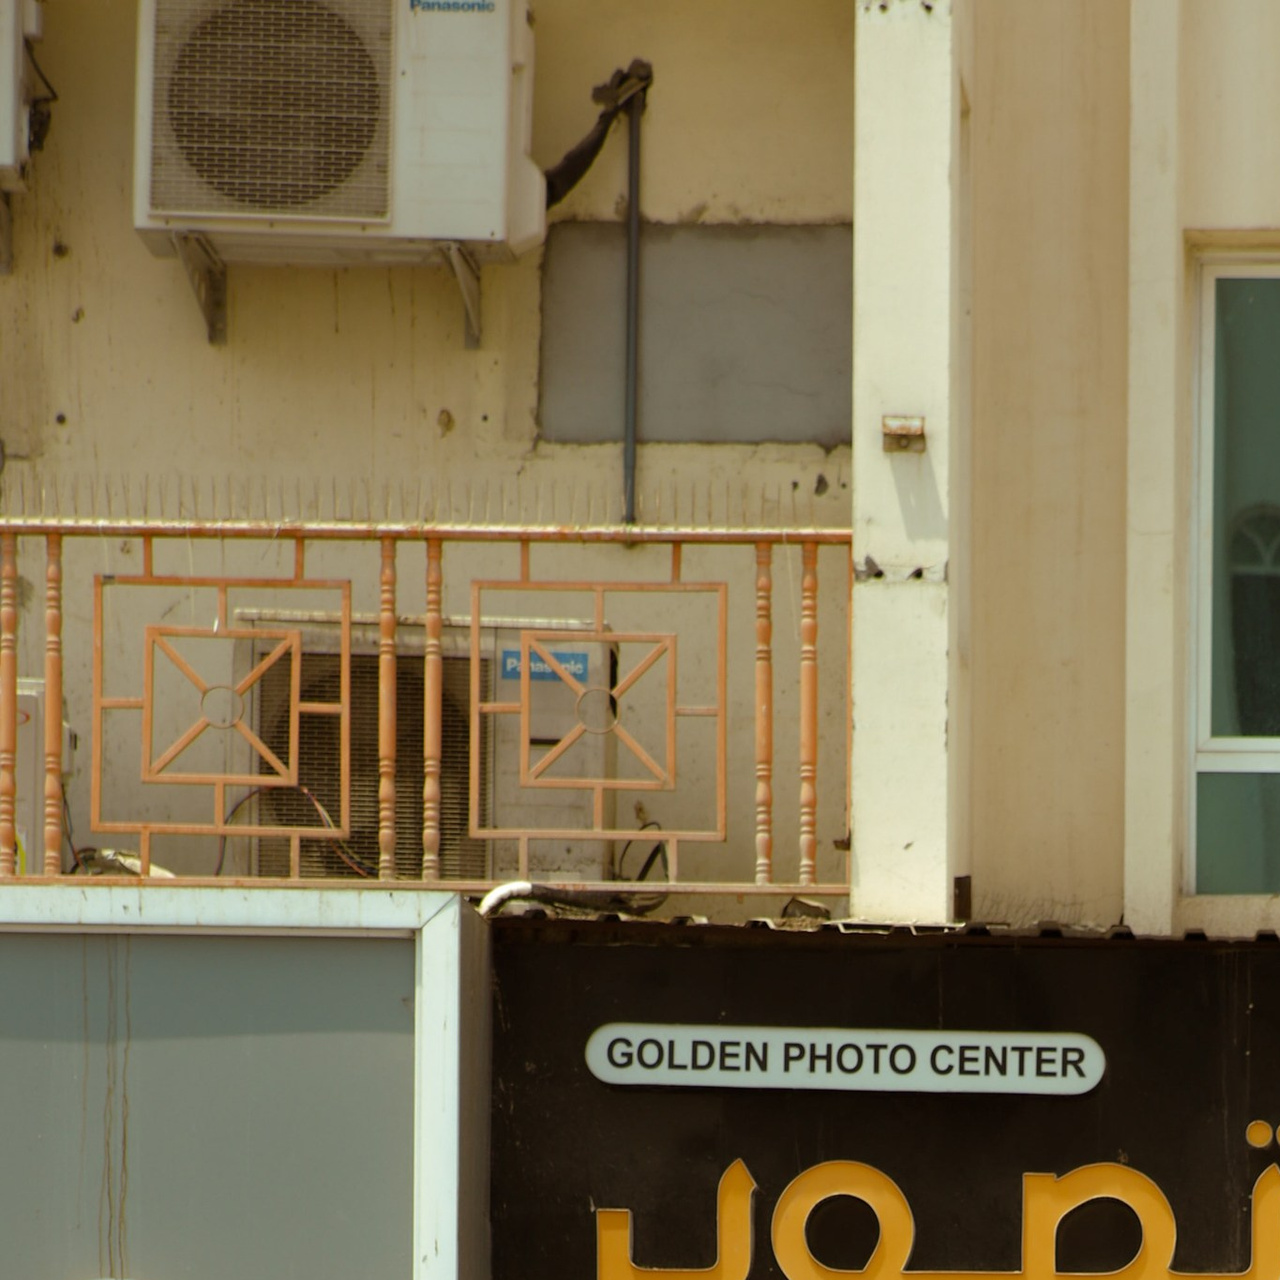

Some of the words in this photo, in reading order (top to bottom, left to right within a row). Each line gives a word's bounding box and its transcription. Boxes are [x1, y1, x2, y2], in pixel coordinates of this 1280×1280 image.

[505, 657, 584, 675] Pnasnic
[606, 1037, 769, 1073] GOLDEN
[783, 1042, 917, 1075] PHOTO
[929, 1044, 1086, 1078] CENTER
